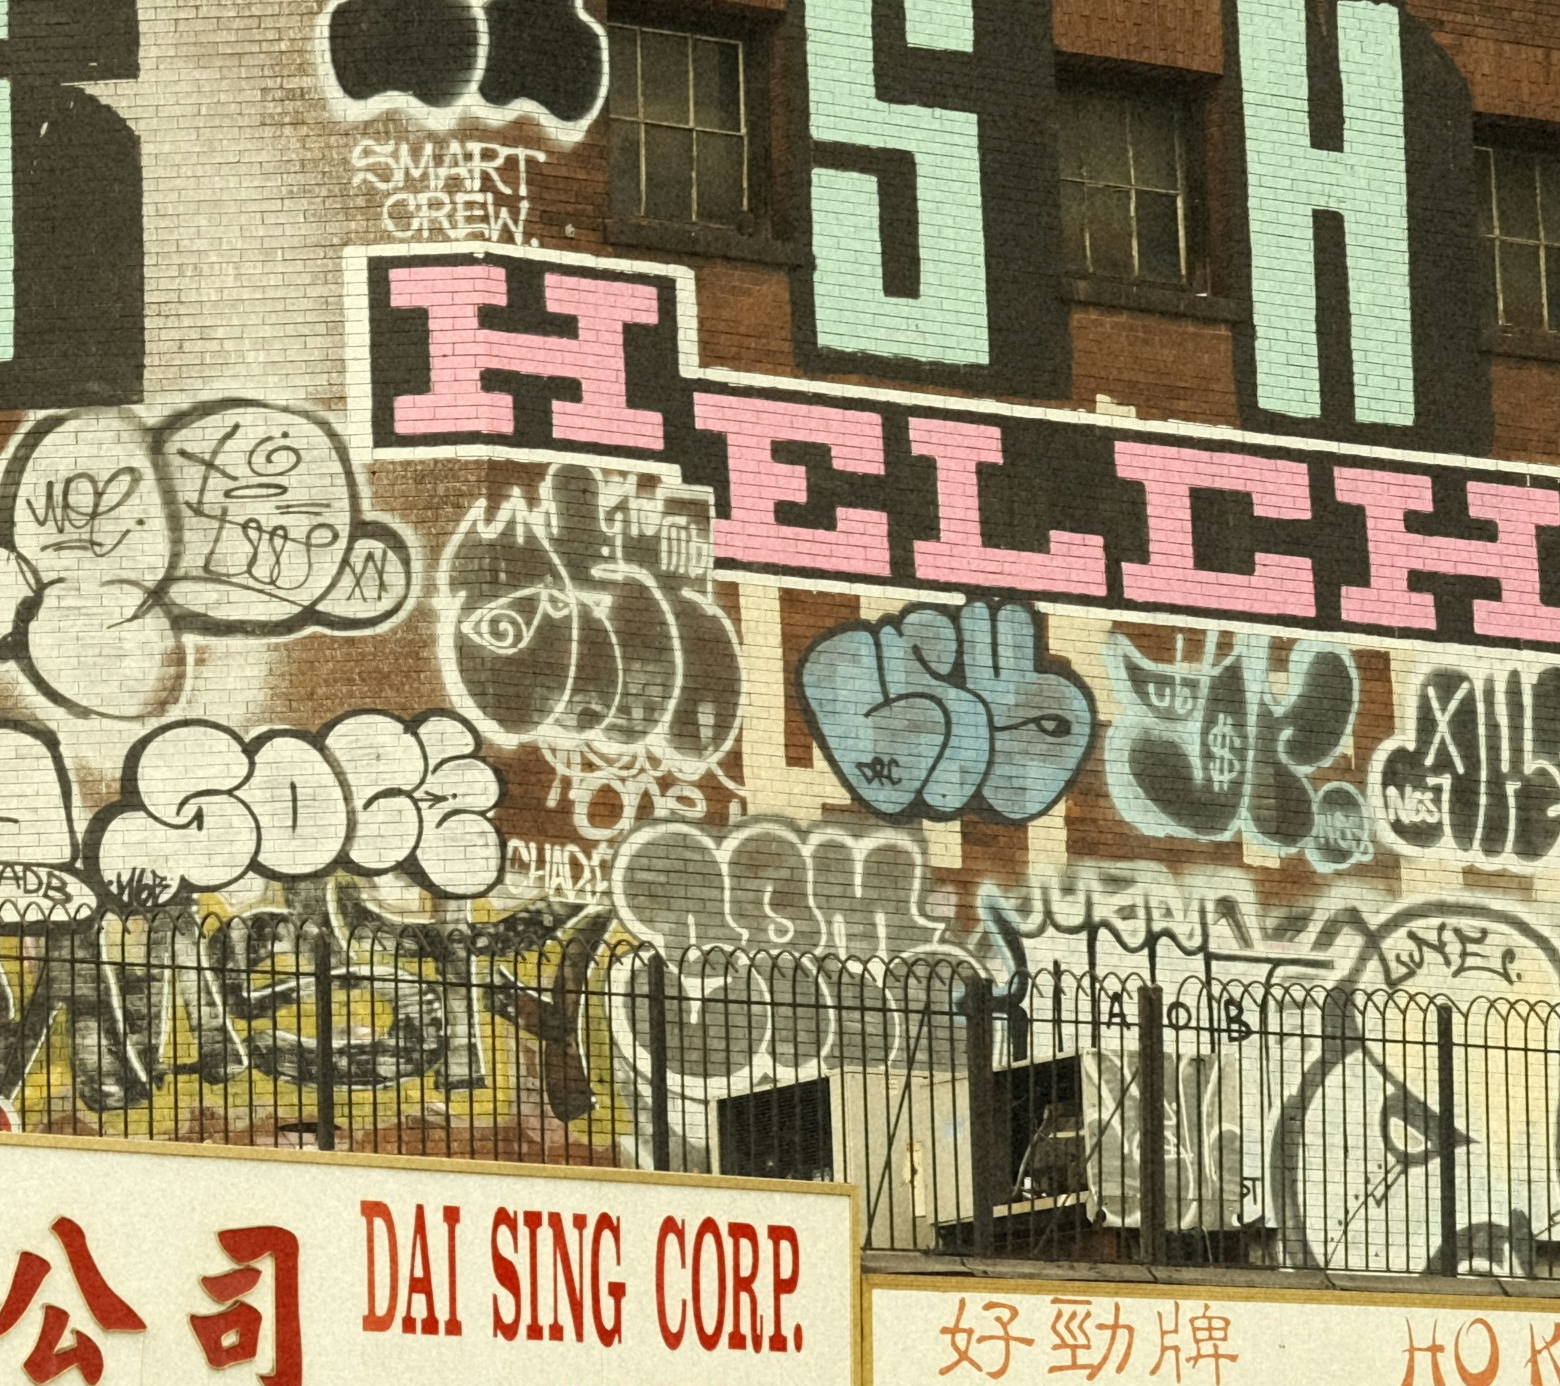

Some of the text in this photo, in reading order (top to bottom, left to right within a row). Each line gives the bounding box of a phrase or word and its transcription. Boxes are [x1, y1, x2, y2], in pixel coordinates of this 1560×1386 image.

[351, 138, 546, 201] SMART
[361, 1199, 807, 1356] DAI SING CORP.
